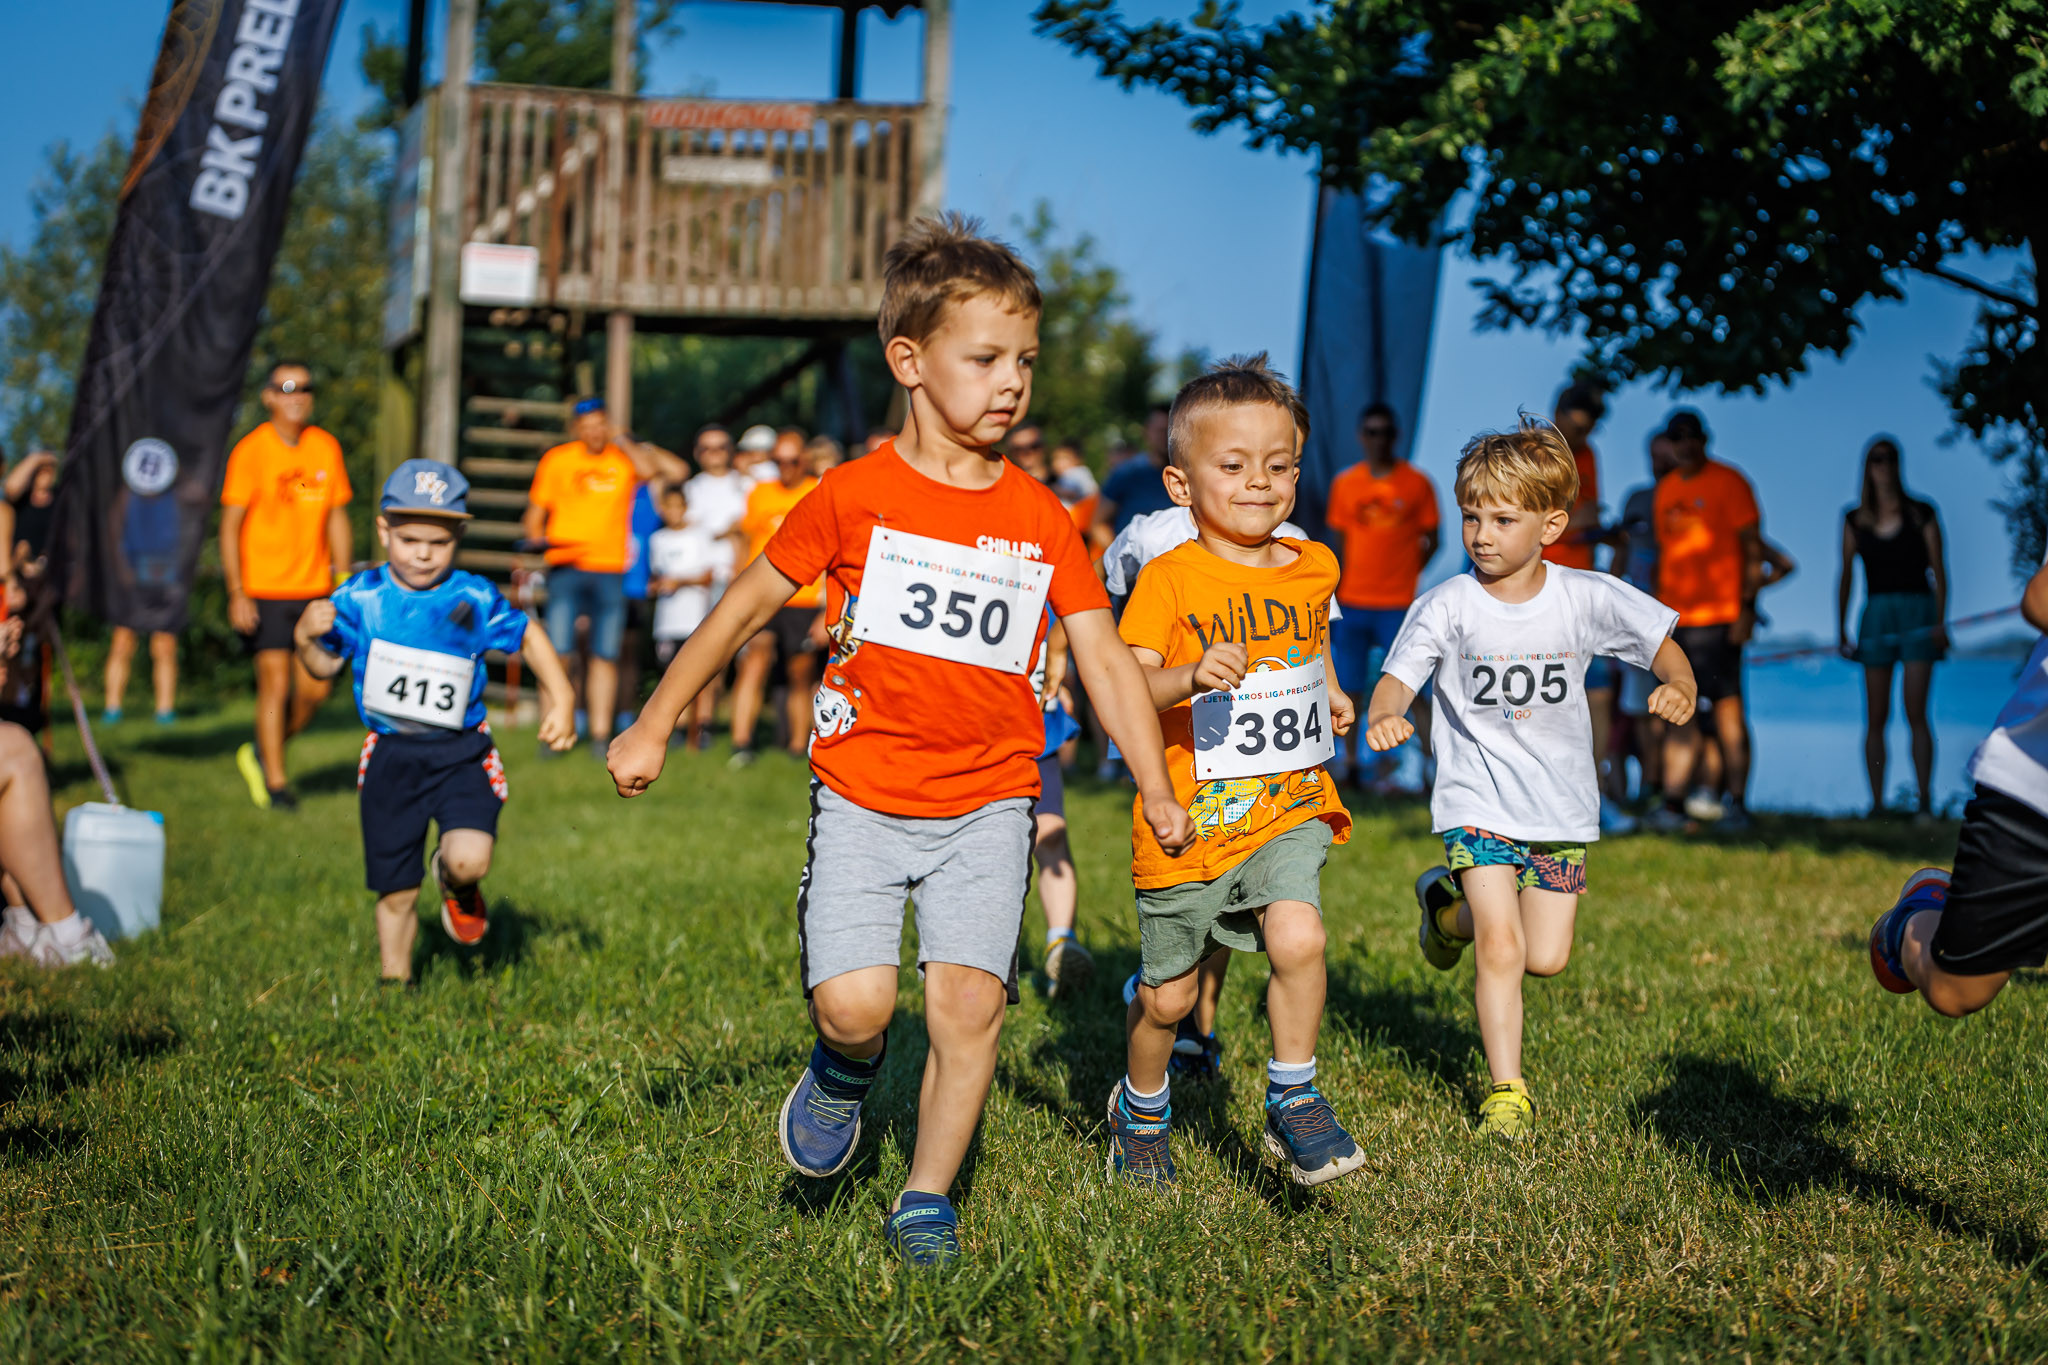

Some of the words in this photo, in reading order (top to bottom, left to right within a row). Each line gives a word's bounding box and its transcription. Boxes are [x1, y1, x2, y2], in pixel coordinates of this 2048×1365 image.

[189, 123, 264, 221] BK
[880, 552, 914, 566] LJETNA
[917, 561, 943, 573] KROS
[946, 566, 967, 577] LIGA
[970, 571, 1004, 585] PRELOG
[900, 583, 1010, 646] 350
[1483, 654, 1505, 662] KROS
[1506, 653, 1525, 661] LIGA
[1526, 652, 1557, 661] PRELOG
[386, 674, 456, 711] 413
[1202, 695, 1236, 704] LJETNA
[1238, 692, 1263, 701] KROS
[1265, 690, 1285, 699] LIGA
[1286, 683, 1311, 696] PRELOG
[1472, 663, 1568, 706] 205
[1235, 701, 1322, 756] 384
[1503, 708, 1532, 720] VIGO
